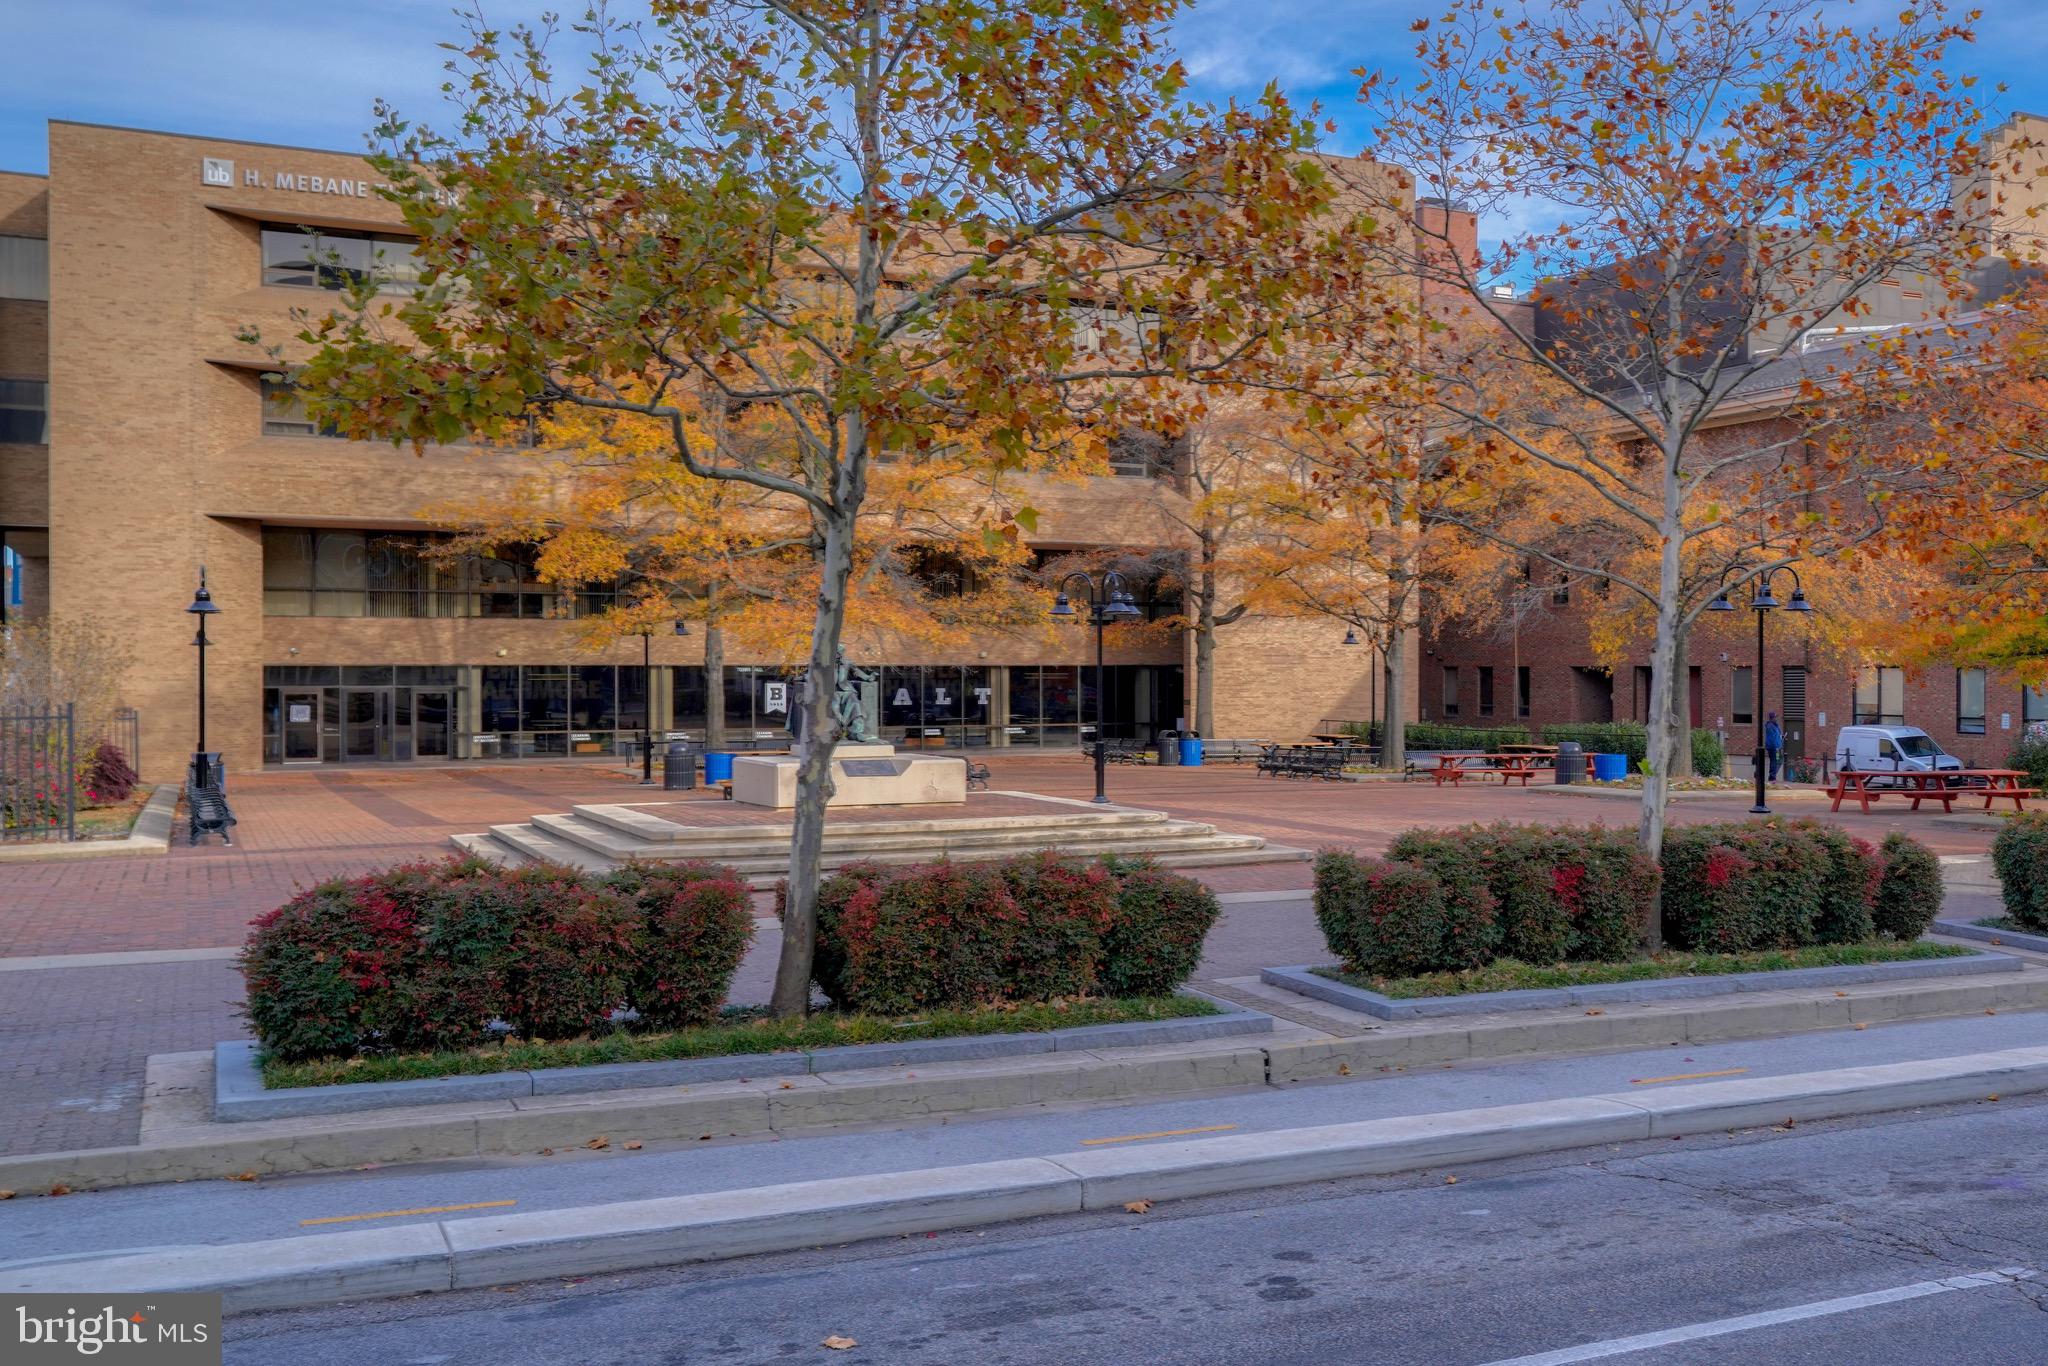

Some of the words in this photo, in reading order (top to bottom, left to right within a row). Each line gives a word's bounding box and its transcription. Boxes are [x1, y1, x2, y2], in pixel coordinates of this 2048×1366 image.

[208, 166, 230, 183] ub
[244, 169, 267, 188] H.
[276, 172, 369, 198] MEBANE
[770, 687, 783, 701] B
